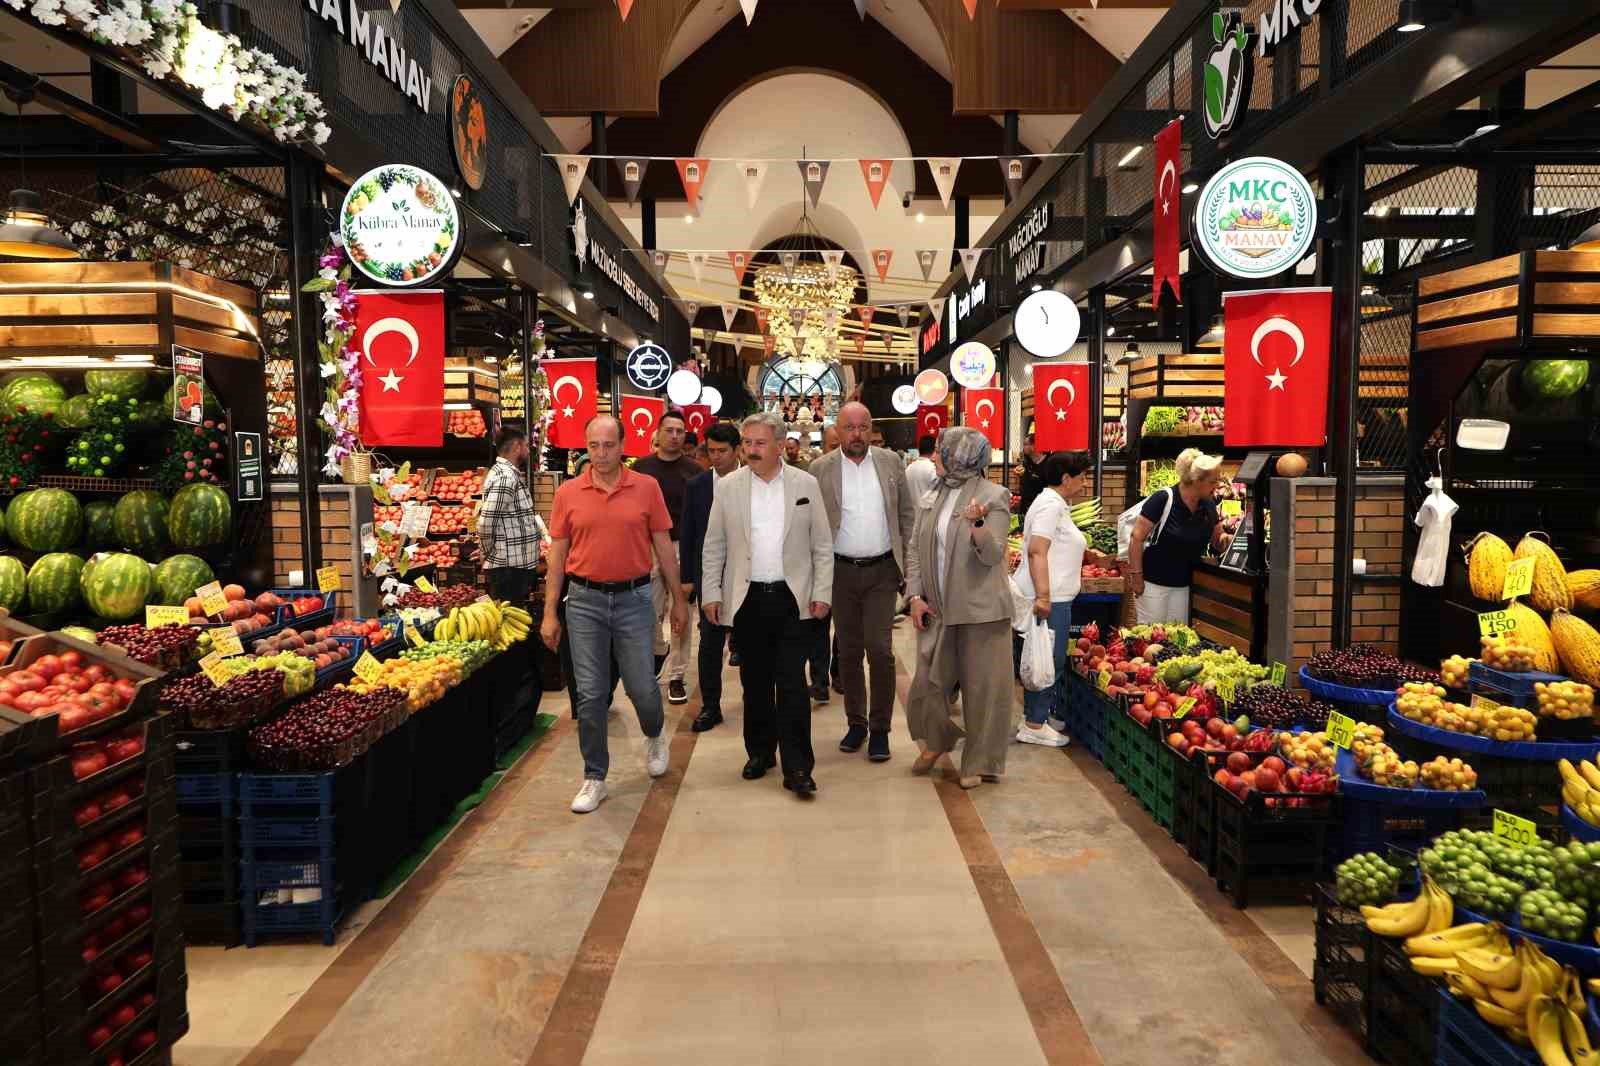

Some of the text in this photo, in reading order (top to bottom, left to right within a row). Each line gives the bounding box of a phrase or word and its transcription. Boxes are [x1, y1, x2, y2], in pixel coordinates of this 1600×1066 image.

[349, 0, 431, 114] MANAV
[1228, 179, 1288, 203] MKC
[358, 214, 399, 230] Kübra
[1225, 233, 1288, 247] MANAV
[1015, 244, 1040, 285] MANAV
[1488, 618, 1516, 634] 150
[1331, 726, 1349, 746] 150
[1499, 824, 1530, 845] 200
